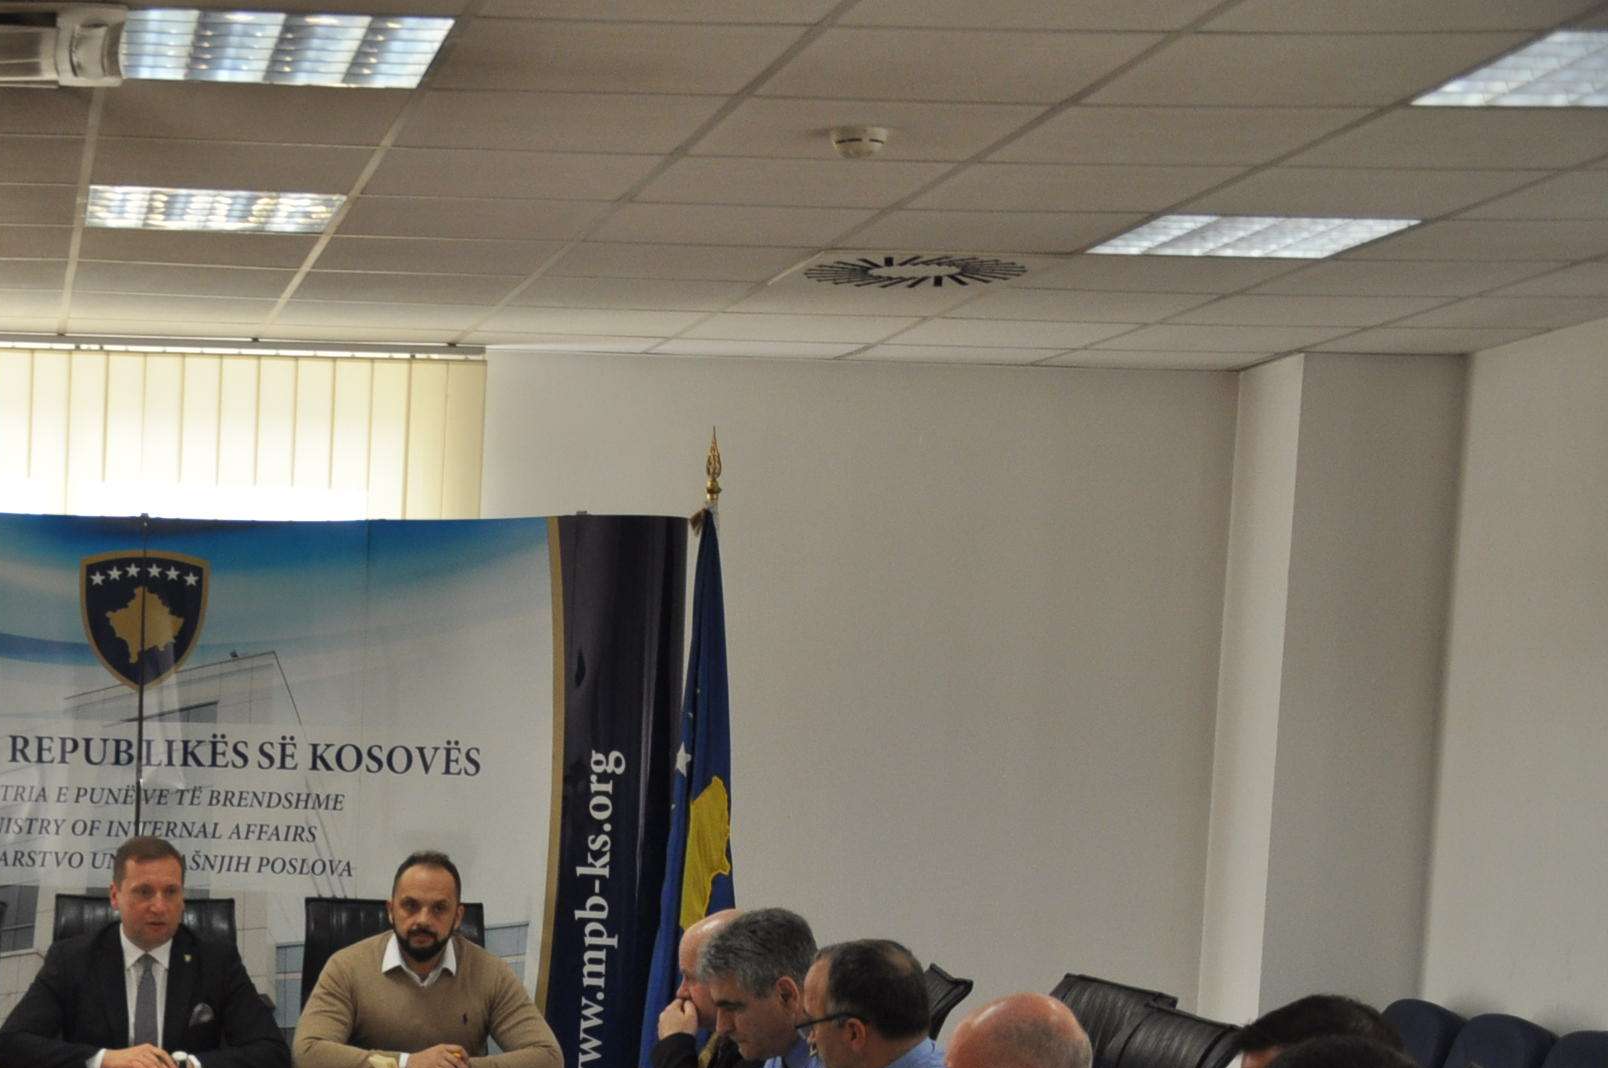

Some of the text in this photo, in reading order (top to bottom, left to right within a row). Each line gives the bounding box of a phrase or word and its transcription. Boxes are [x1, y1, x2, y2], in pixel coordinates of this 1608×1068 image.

[8, 732, 249, 769] REPUBLIKËS
[257, 735, 298, 771] SË
[308, 739, 481, 777] KOSOVËS
[56, 786, 69, 803] E
[175, 786, 203, 806] TË
[208, 790, 345, 812] BRENDSHME
[72, 819, 102, 837] OF
[106, 819, 222, 840] INTERNAL
[228, 824, 317, 843] AFFAIRS
[257, 856, 353, 878] POSLOVA
